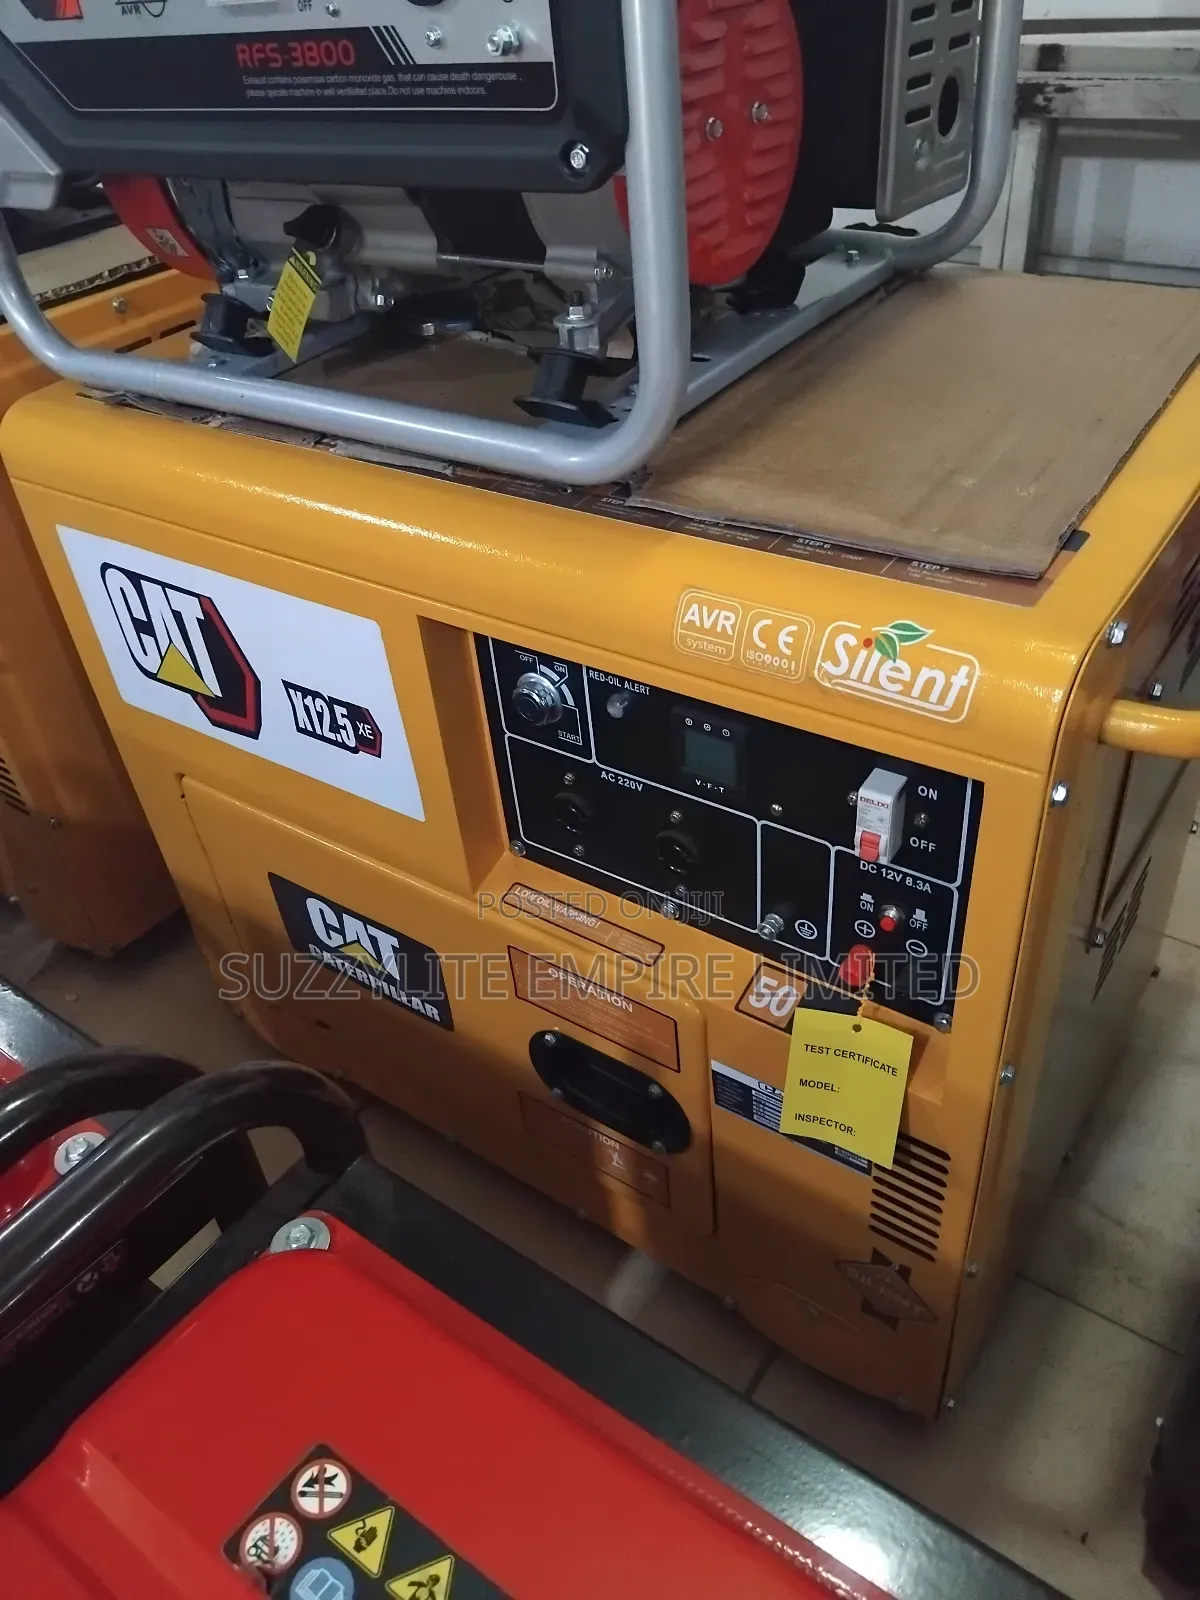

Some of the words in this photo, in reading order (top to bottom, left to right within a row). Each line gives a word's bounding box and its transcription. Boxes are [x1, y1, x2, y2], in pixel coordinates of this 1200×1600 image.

[121, 5, 142, 16] AVR
[236, 40, 356, 68] RFS-3800
[326, 73, 348, 83] carbon
[412, 73, 426, 81] can
[427, 73, 449, 81] cause
[450, 71, 471, 81] death
[412, 86, 425, 95] use
[426, 85, 456, 95] machine
[797, 537, 824, 548] STEP
[910, 561, 941, 571] STEP
[682, 603, 736, 636] AVR
[104, 567, 223, 698] CAT
[752, 619, 798, 656] CE
[686, 638, 726, 655] system
[519, 654, 534, 664] OFF
[746, 649, 796, 671] ISO9001
[554, 664, 565, 673] ON
[823, 632, 970, 708] Silent
[589, 669, 622, 688] RED-OIL
[624, 680, 650, 696] ALERT
[355, 720, 375, 740] XE
[557, 729, 581, 743] START
[600, 770, 616, 782] AC
[617, 776, 644, 792] 220V
[917, 785, 939, 801] ON
[859, 796, 890, 809] DELIXI
[909, 836, 937, 853] OFF
[859, 860, 877, 874] DC
[881, 867, 903, 883] 12V
[905, 876, 932, 894] 8.3A
[536, 896, 551, 909] OIL
[859, 900, 874, 913] ON
[909, 918, 929, 932] OFF
[305, 897, 400, 981] CAT
[308, 943, 441, 1022] CATERPILLAR
[547, 967, 634, 1013] OPERATION
[748, 975, 797, 1017] 50
[803, 1043, 831, 1055] TEST
[833, 1048, 898, 1077] CERTIFICATE
[799, 1078, 841, 1094] MODEL:
[794, 1112, 857, 1137] INSPECTOR:
